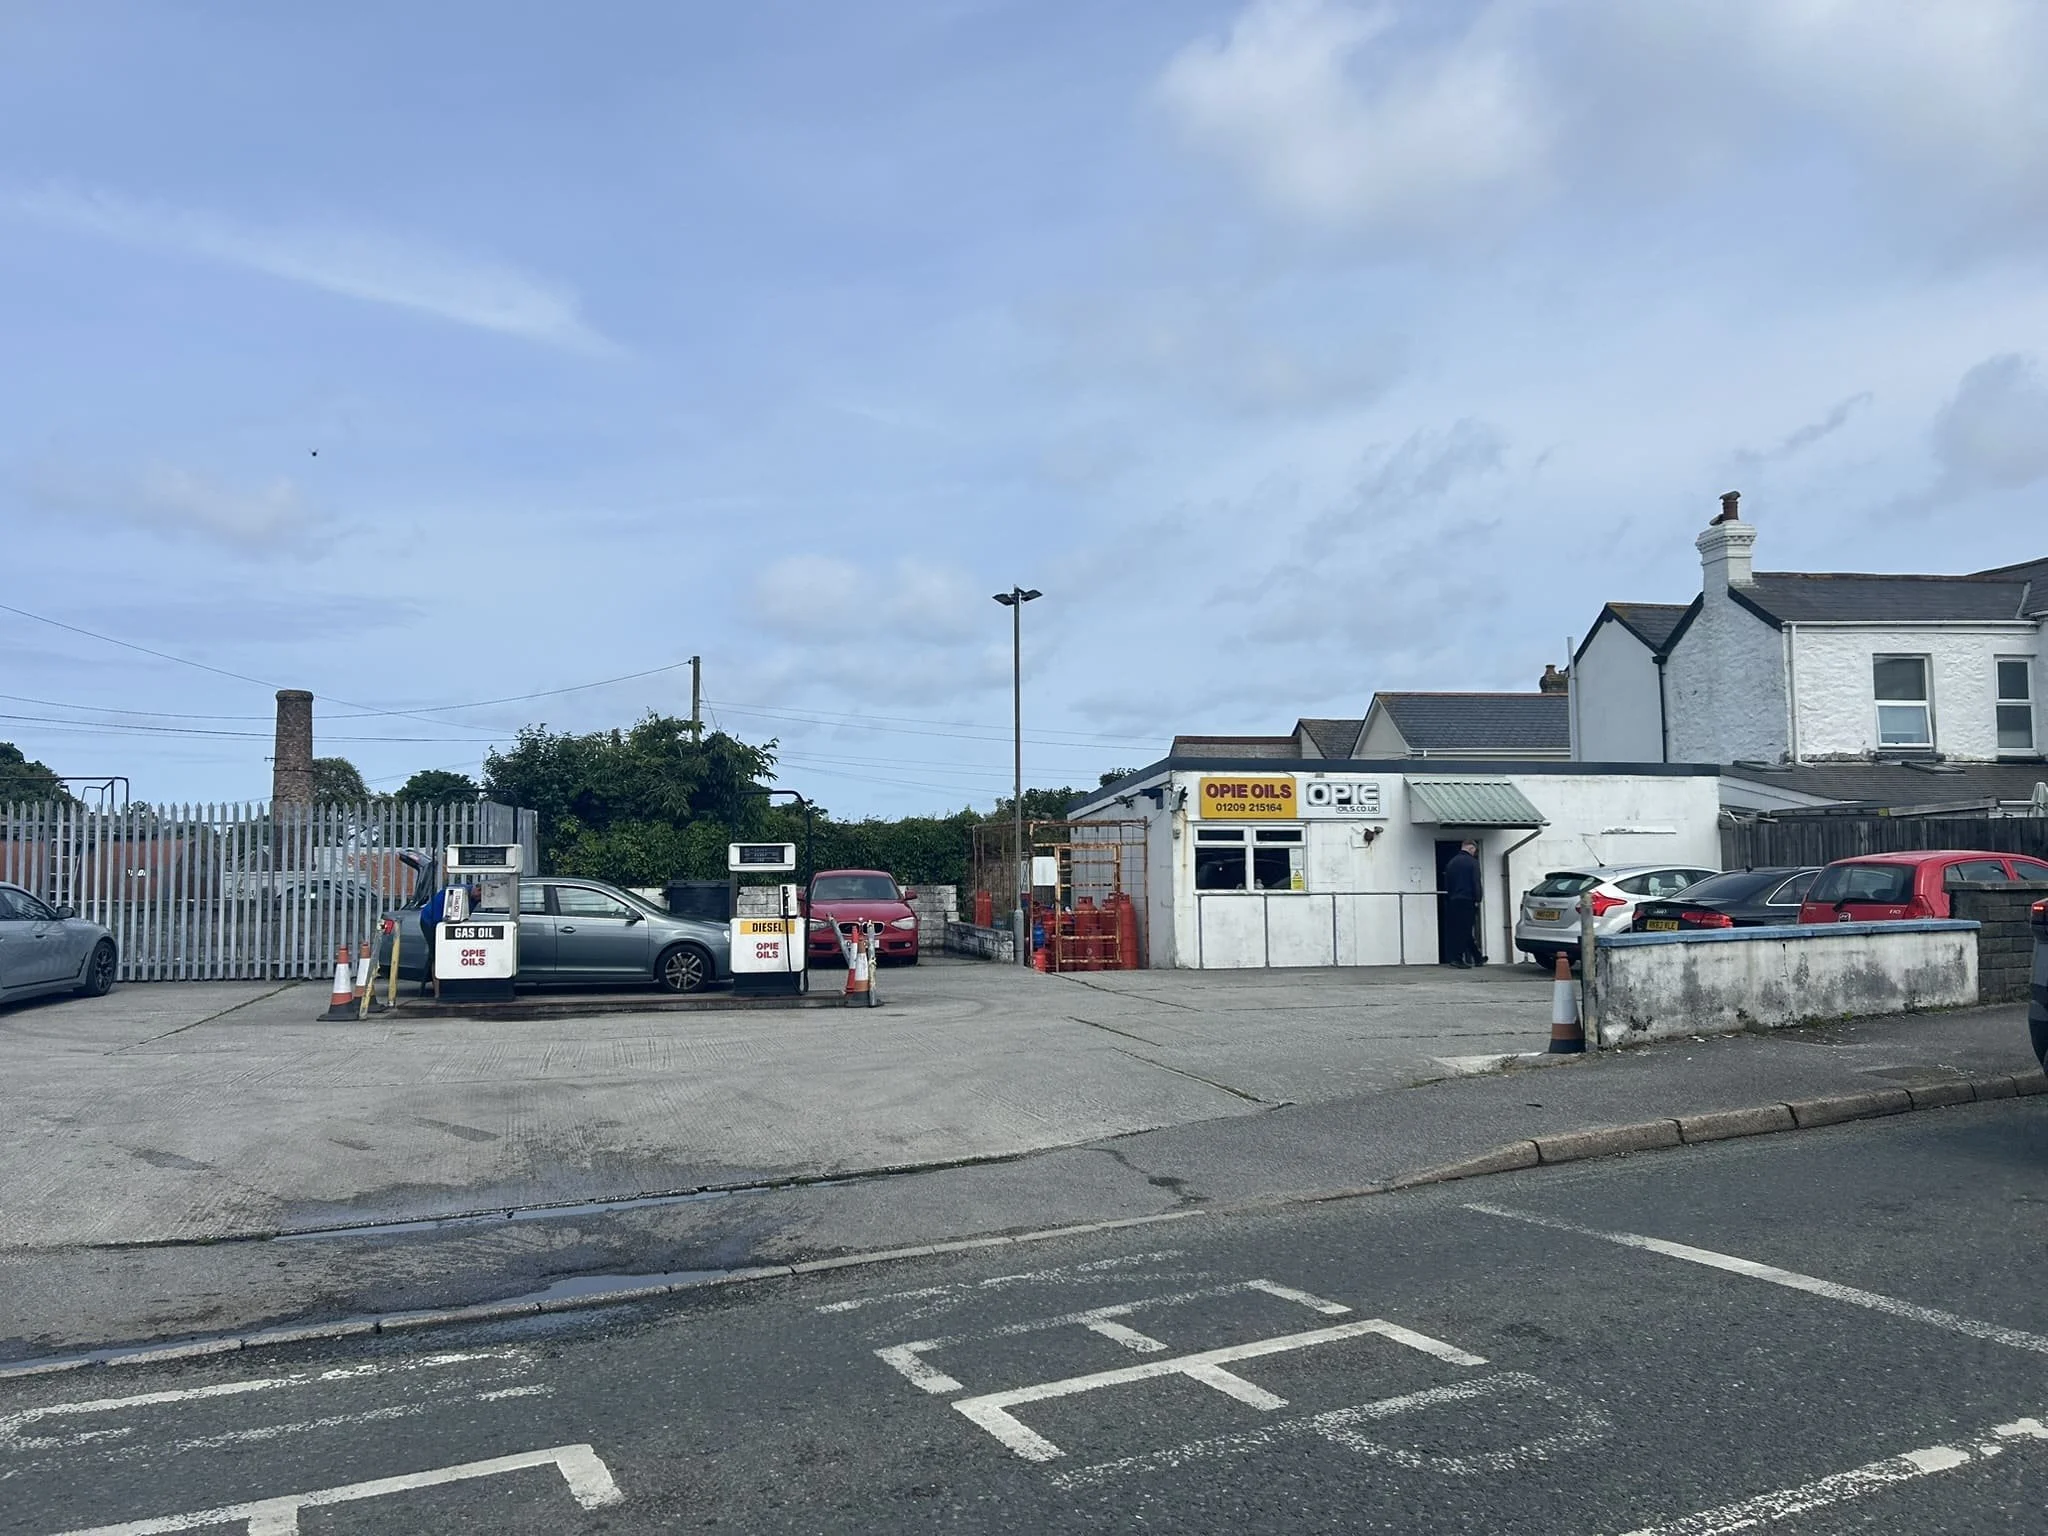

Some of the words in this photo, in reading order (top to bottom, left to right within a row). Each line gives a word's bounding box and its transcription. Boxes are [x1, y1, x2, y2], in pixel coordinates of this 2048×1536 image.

[1205, 783, 1249, 799] OPIE
[1250, 783, 1293, 799] OILS
[1306, 782, 1381, 807] OPIE
[1215, 803, 1246, 812] 01209
[1248, 803, 1282, 812] 215164
[752, 922, 784, 933] DIESEL
[454, 927, 475, 939] GAS
[477, 927, 495, 939] OIL
[755, 942, 780, 951] OPIE
[460, 949, 486, 958] OPIE
[755, 950, 779, 959] OILS
[460, 957, 486, 966] OILS
